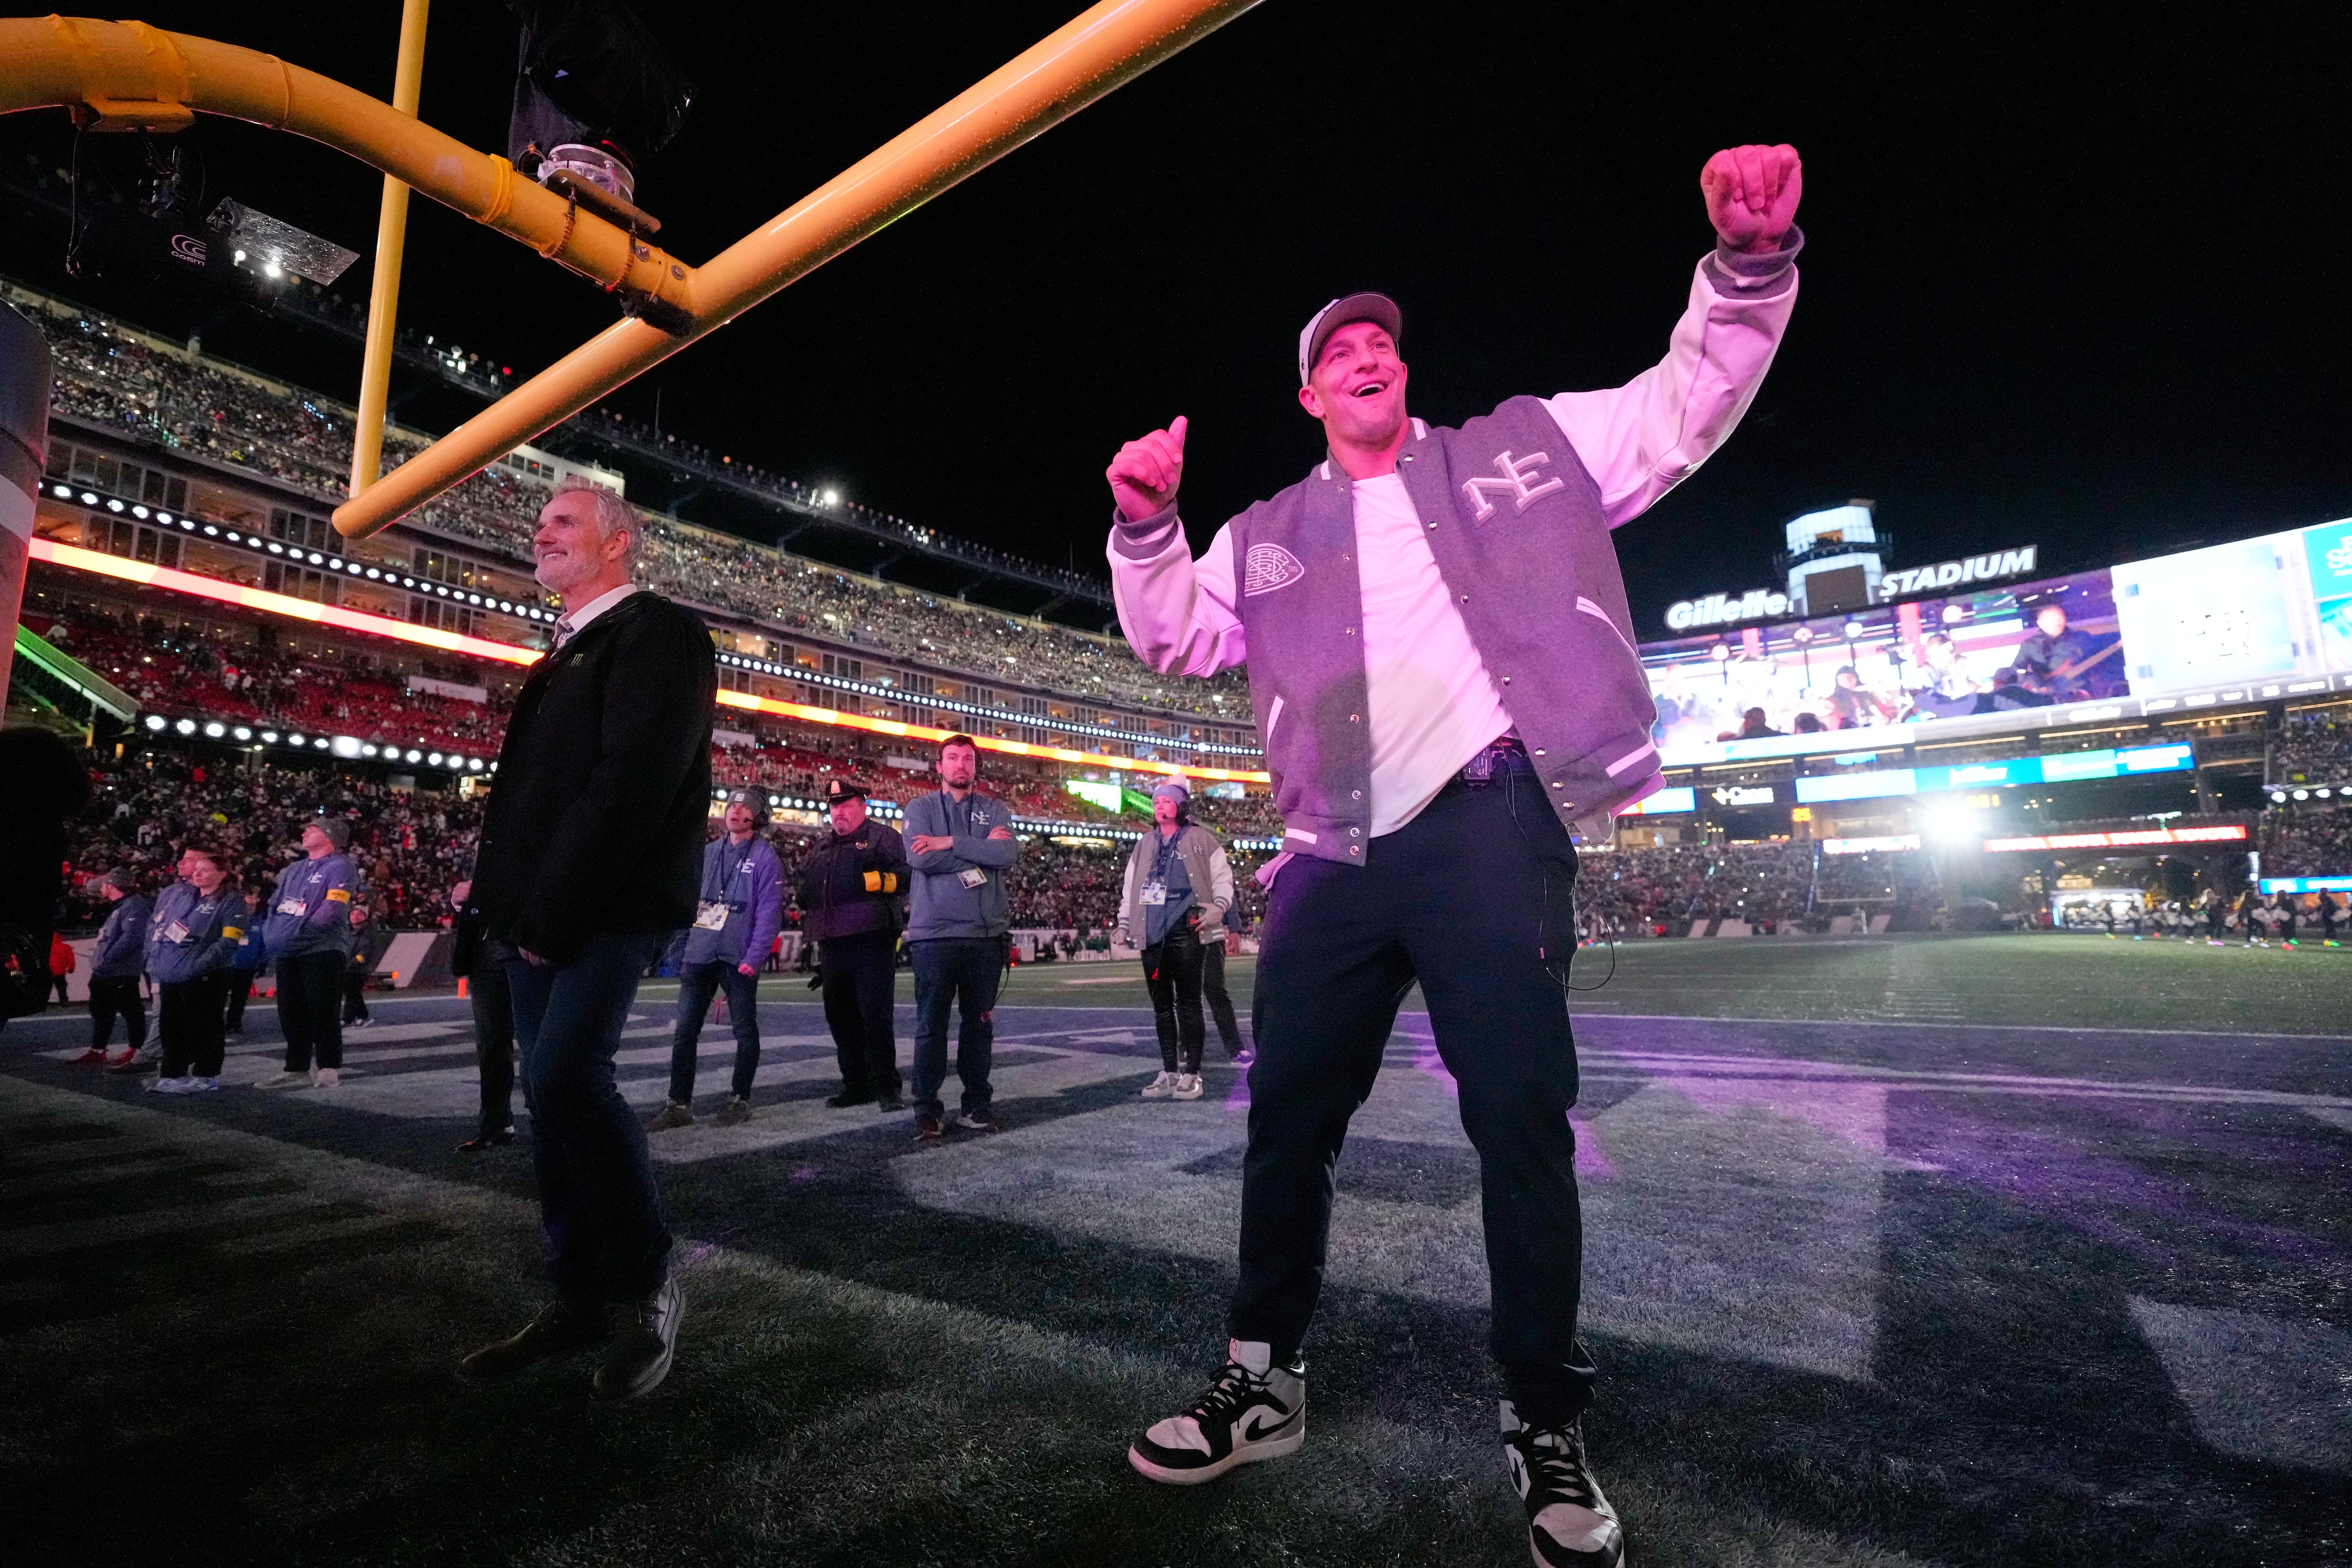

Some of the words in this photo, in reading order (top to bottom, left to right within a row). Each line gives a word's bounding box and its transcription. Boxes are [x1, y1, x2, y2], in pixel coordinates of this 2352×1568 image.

[1461, 450, 1565, 521] NE
[1666, 589, 1788, 629] Gillette
[1879, 548, 2034, 596] STADIUM
[971, 811, 989, 825] NE
